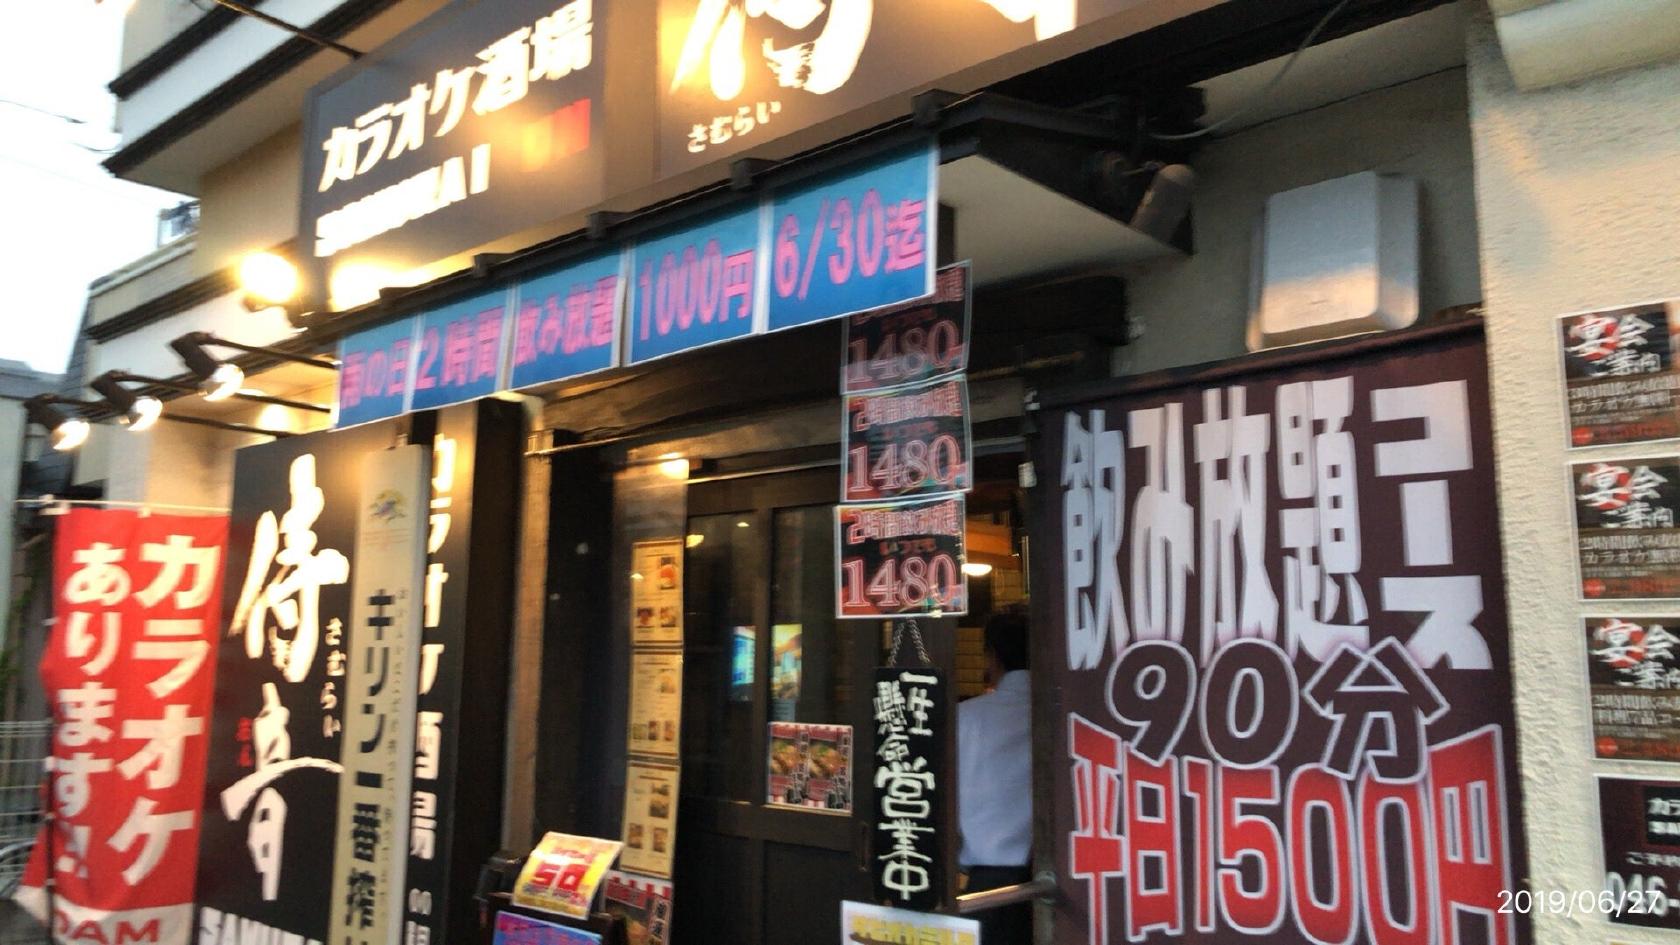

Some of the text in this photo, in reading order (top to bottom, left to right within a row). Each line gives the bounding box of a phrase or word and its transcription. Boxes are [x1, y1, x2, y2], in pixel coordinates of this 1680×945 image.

[317, 0, 594, 192] カラオケ酒場
[686, 101, 782, 153] さむらい
[637, 239, 756, 342] 1000円
[774, 187, 928, 302] 6/30迄
[848, 319, 962, 385] 1480
[847, 434, 962, 493] 1480
[1060, 376, 1494, 671] 飲み放題 コース
[841, 553, 958, 608] 1480
[106, 534, 222, 887] カラオケ
[320, 616, 347, 739] さむらい
[1105, 635, 1451, 784] 90分
[343, 588, 396, 945] キリン一番搾
[873, 755, 937, 901] 営業中
[1068, 712, 1516, 945] 平日1500円
